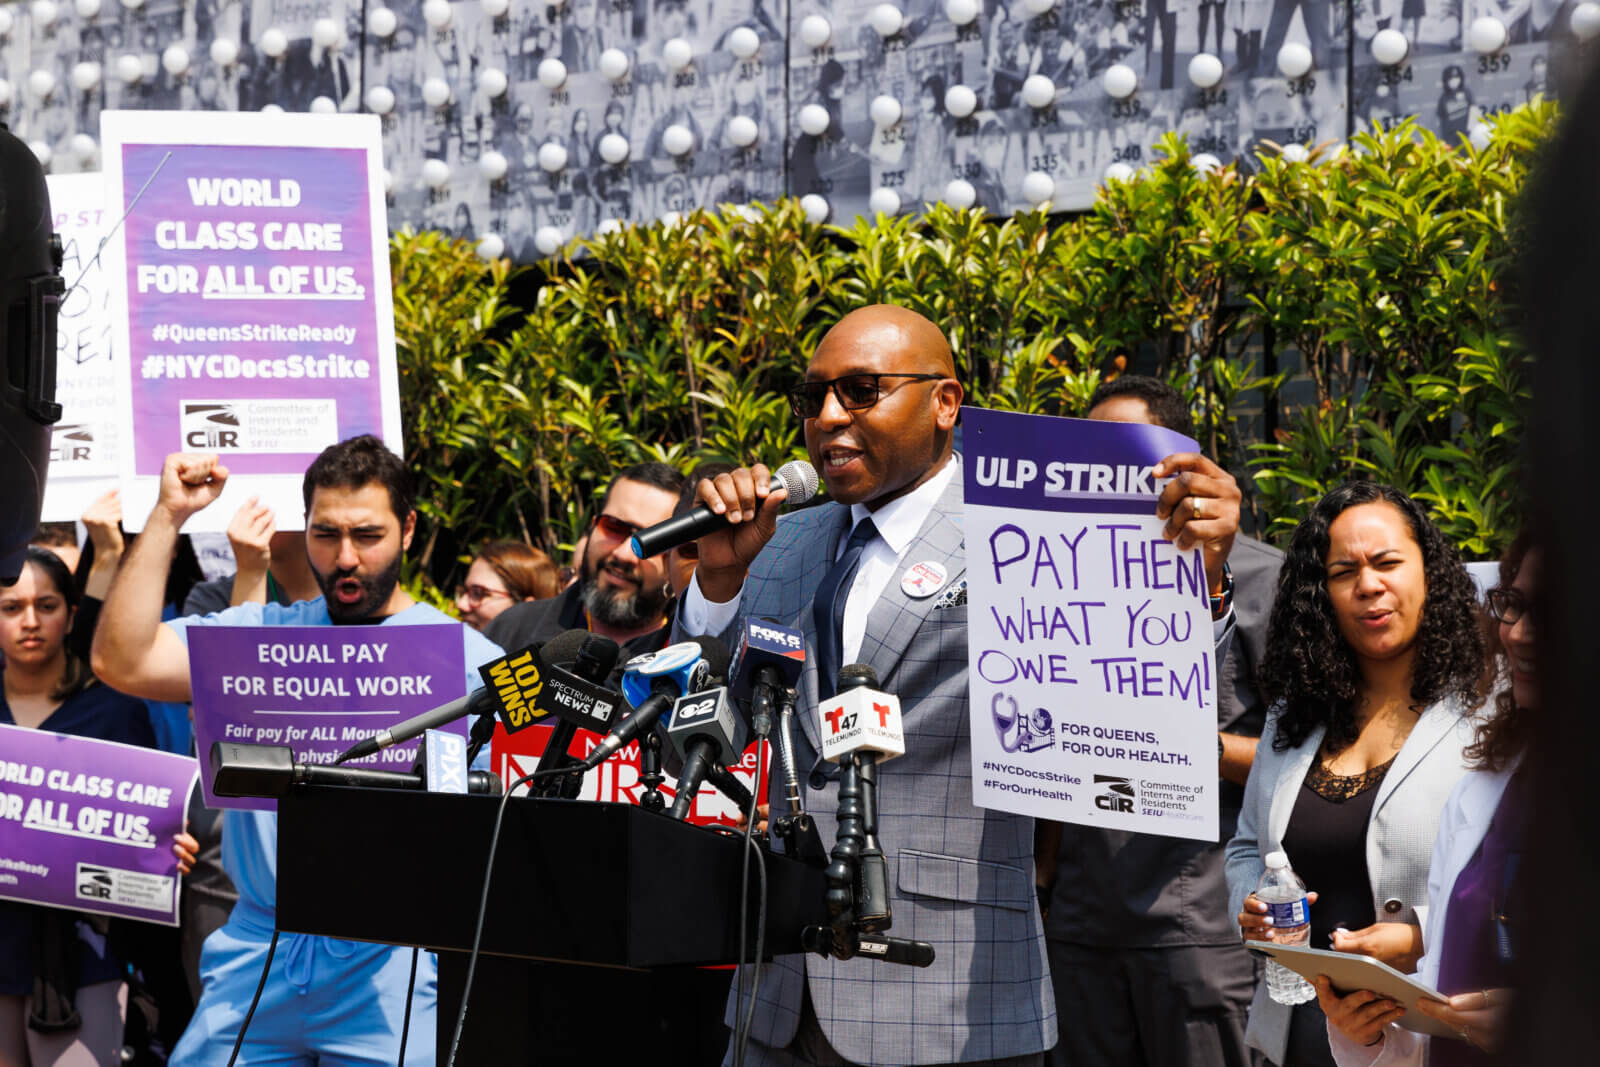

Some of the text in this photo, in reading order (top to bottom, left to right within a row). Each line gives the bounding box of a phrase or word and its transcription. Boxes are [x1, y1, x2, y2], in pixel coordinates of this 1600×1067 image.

[1478, 54, 1511, 74] 359
[1032, 155, 1057, 171] 335
[1113, 145, 1141, 162] 340
[187, 178, 301, 207] WORLD
[155, 221, 343, 251] CLASS CARE
[137, 265, 365, 294] FOR ALL OF US.
[152, 324, 356, 345] #QueensStrikeReady
[141, 354, 370, 379] #NYCDocsStrike
[975, 456, 1038, 489] ULP
[989, 523, 1209, 609] PAY THEM
[991, 597, 1192, 648] WHAT YOU
[258, 643, 388, 667] EQUAL PAY
[222, 675, 432, 700] FOR EQUAL WORK
[978, 650, 1210, 709] OWE THEM!
[489, 660, 532, 727] WINS
[549, 679, 594, 705] SPECTRUM
[554, 691, 591, 715] NEWS
[696, 699, 716, 716] 2
[841, 712, 858, 730] 47
[225, 724, 254, 739] Fair
[256, 727, 284, 742] pay
[284, 725, 308, 743] for
[311, 727, 338, 741] ALL
[825, 728, 862, 747] TELEMUNDO
[1061, 722, 1160, 746] FOR QUEENS,
[1062, 741, 1192, 767] FOR OUR HEALTH.
[0, 760, 172, 808] ORLD CLASS CARE
[983, 761, 1082, 785] #NYCDocsStrike
[984, 779, 1073, 802] #ForOurHealth
[1140, 779, 1204, 794] Committee of
[1141, 789, 1195, 802] Interns and
[1141, 797, 1187, 810] Residents
[1142, 808, 1163, 817] SEIU
[0, 792, 156, 844] OR ALL OF US.
